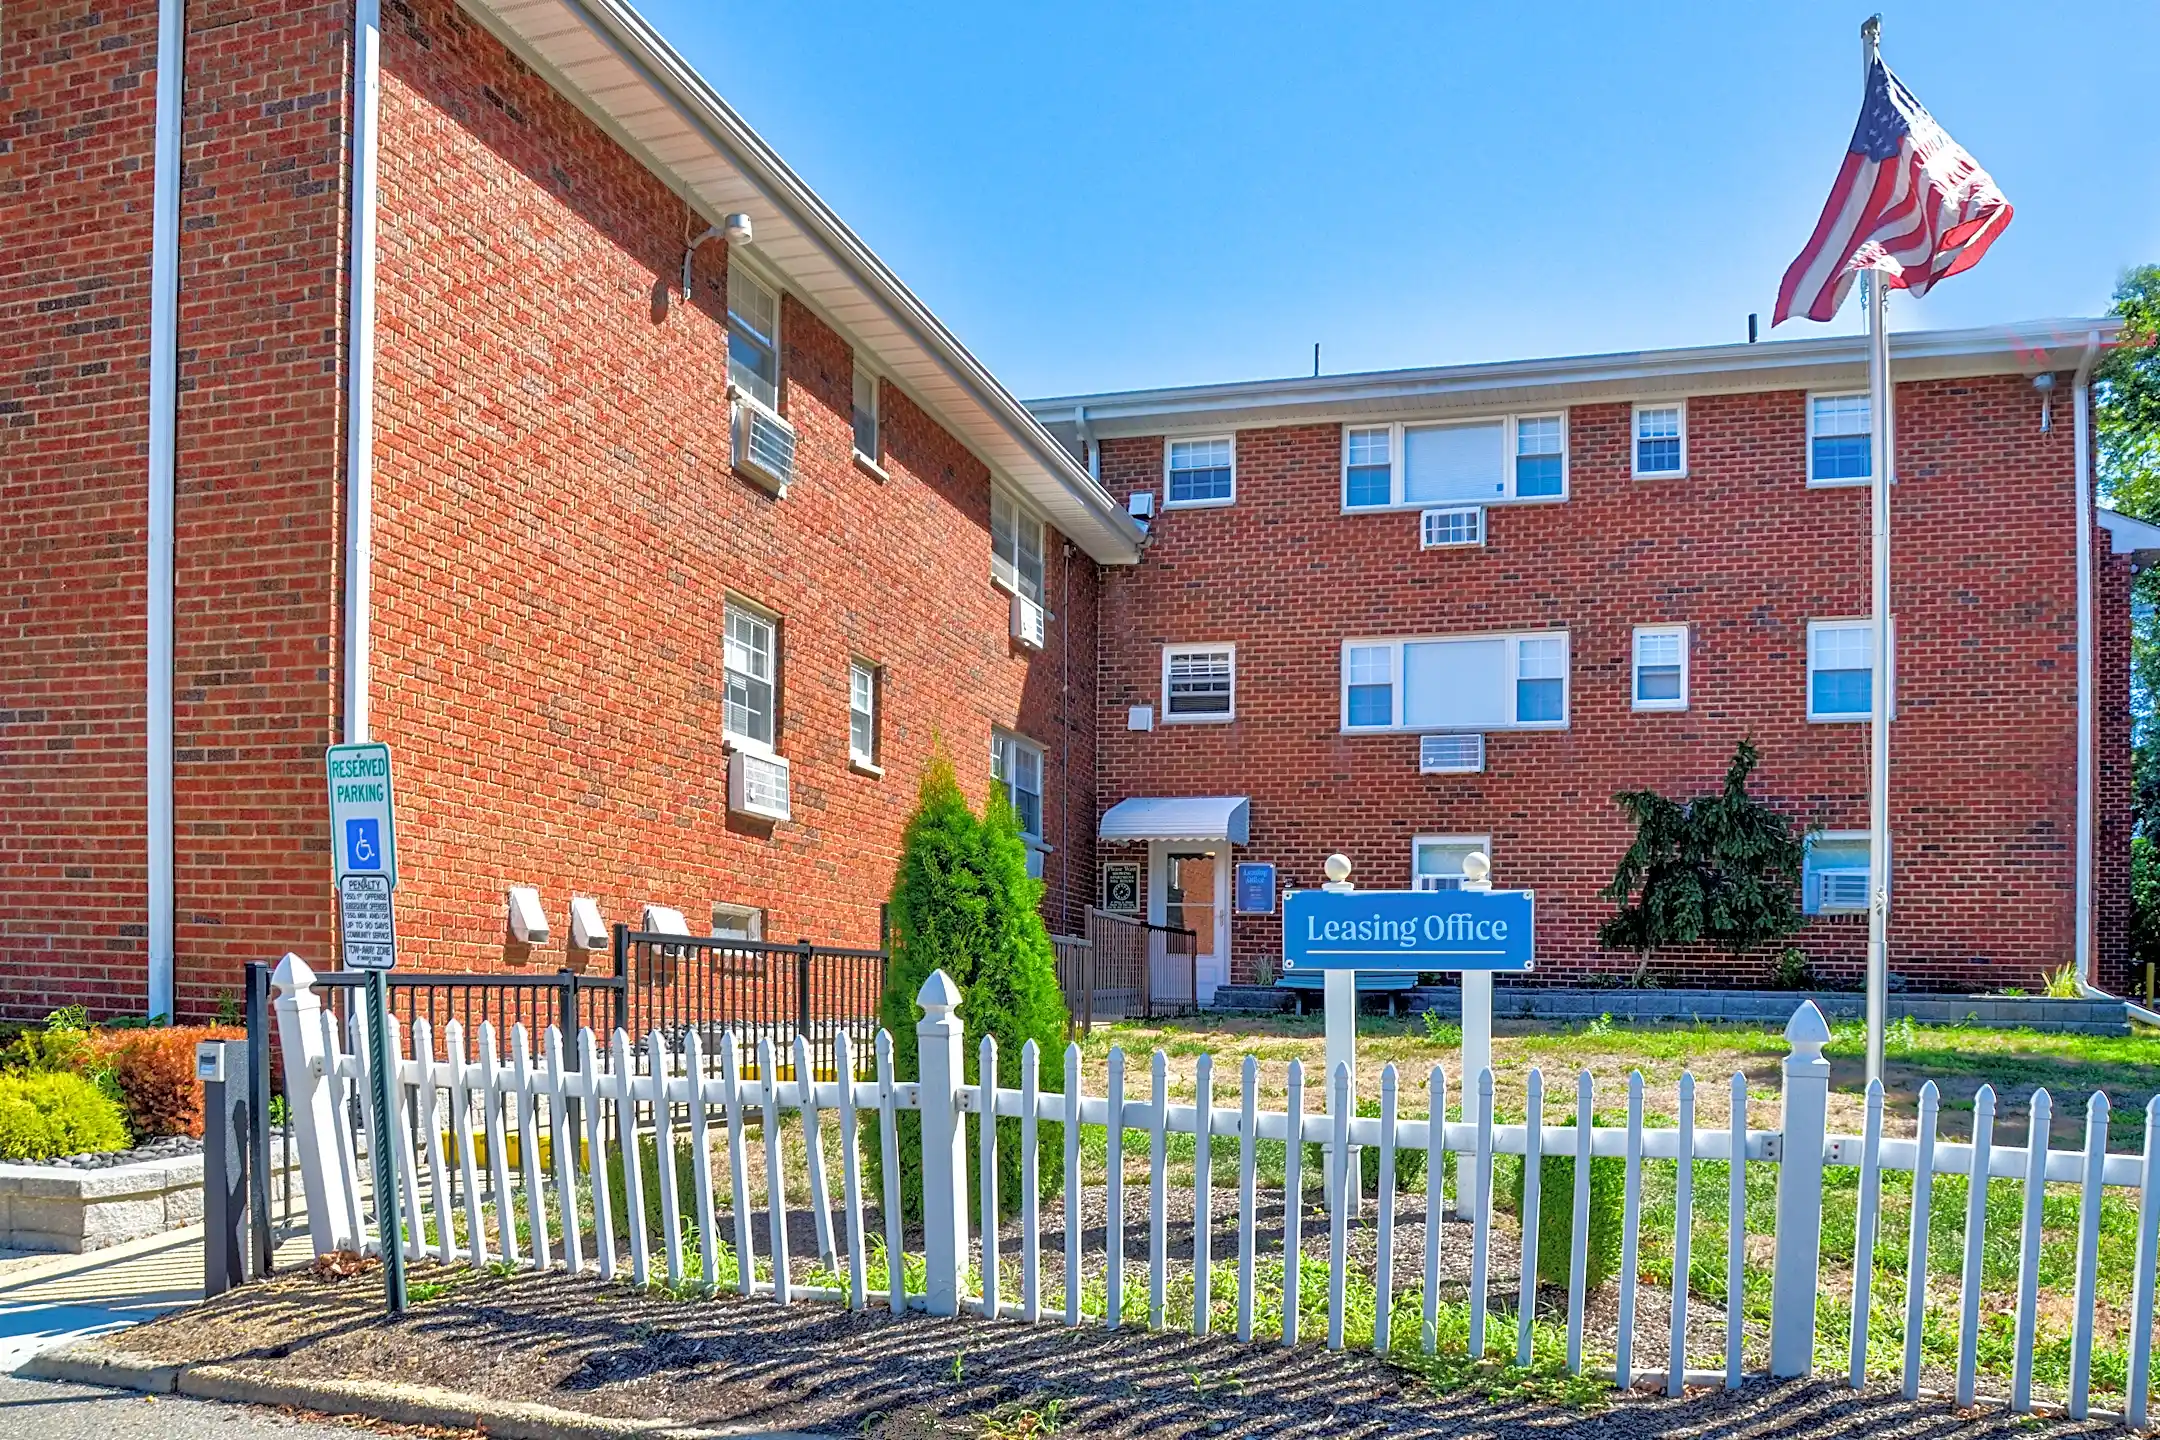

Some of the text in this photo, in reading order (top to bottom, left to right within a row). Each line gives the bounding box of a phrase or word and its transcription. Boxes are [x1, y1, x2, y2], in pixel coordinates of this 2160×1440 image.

[332, 758, 385, 778] RESERVED
[337, 783, 384, 803] PARKING
[1243, 868, 1268, 877] Leasing
[348, 880, 381, 890] PENALTY
[364, 893, 387, 901] OFFENSE
[346, 921, 389, 930] UP TO 90 DAYS
[1307, 912, 1508, 948] Leasing Office
[346, 931, 390, 940] COMMUNITY SERVICE
[348, 944, 391, 956] TOW-AWAY ZONE
